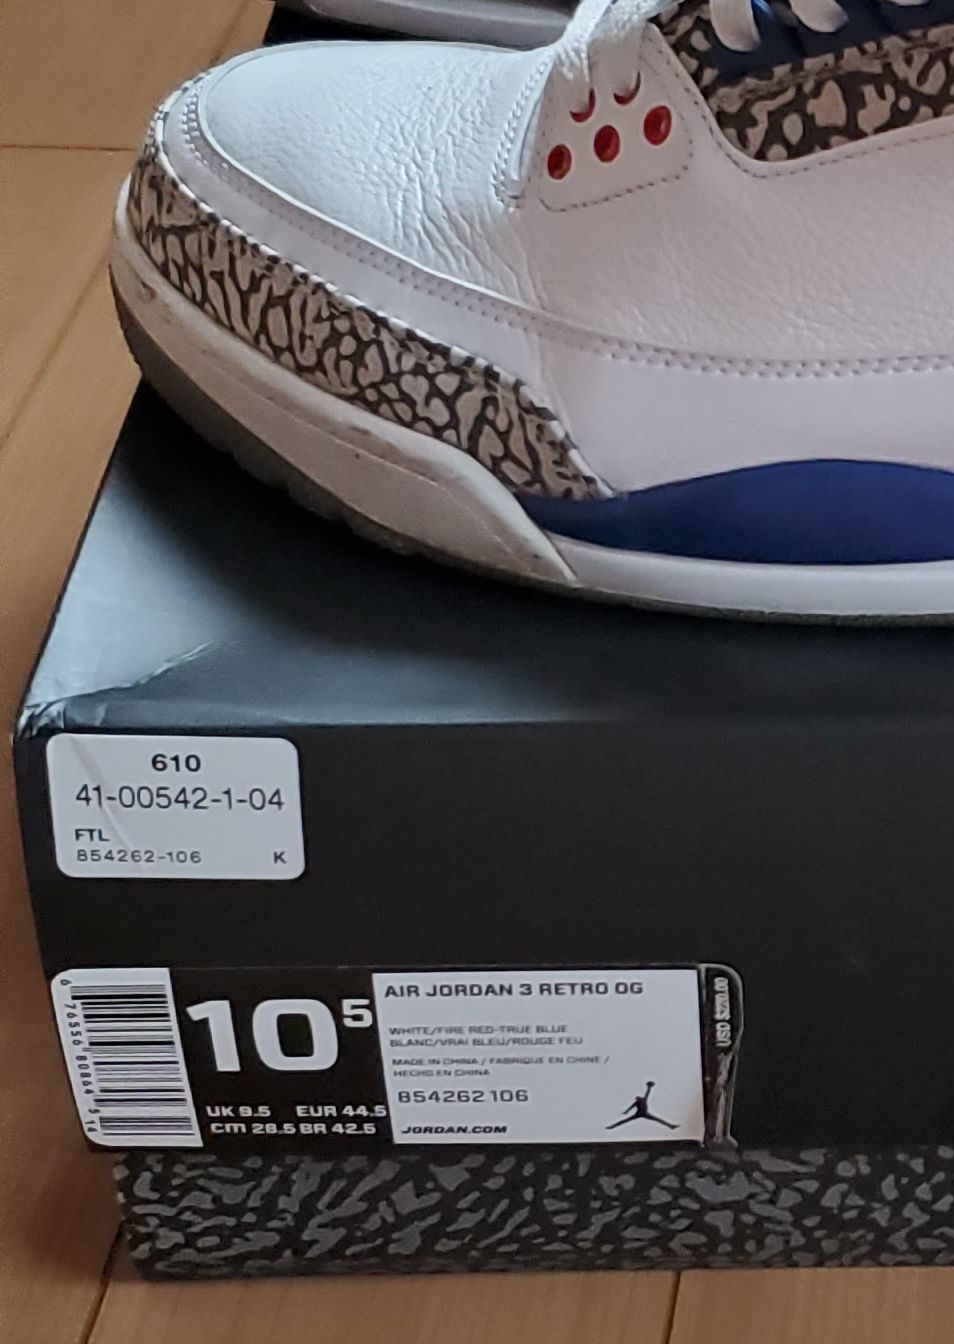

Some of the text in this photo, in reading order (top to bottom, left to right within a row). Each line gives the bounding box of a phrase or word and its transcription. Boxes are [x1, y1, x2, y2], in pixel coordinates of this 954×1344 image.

[151, 754, 201, 772] 610
[75, 783, 285, 811] 41-00542-1-04
[75, 828, 110, 842] FTL
[76, 849, 287, 865] 854262-106 K
[384, 982, 644, 998] AIR JORDAN 3 RETRO OG
[186, 998, 339, 1072] 10
[388, 1025, 466, 1036] WHITE/FIRE
[536, 1024, 568, 1034] BLUE
[715, 1022, 732, 1046] USD
[390, 1036, 584, 1048] BLANC/VRAI BLEU/ROUGE FEU
[392, 1058, 425, 1066] MADE
[428, 1058, 440, 1066] IN
[442, 1058, 479, 1066] CHINA
[549, 1056, 564, 1065] EN
[436, 1069, 452, 1077] EN
[454, 1069, 490, 1077] CHINA
[206, 1105, 387, 1118] UK 9.5 EUR 44.5
[252, 1123, 297, 1135] 28.5
[299, 1123, 327, 1134] BR
[331, 1123, 376, 1134] 42.5
[401, 1125, 508, 1135] JORDAN.COM
